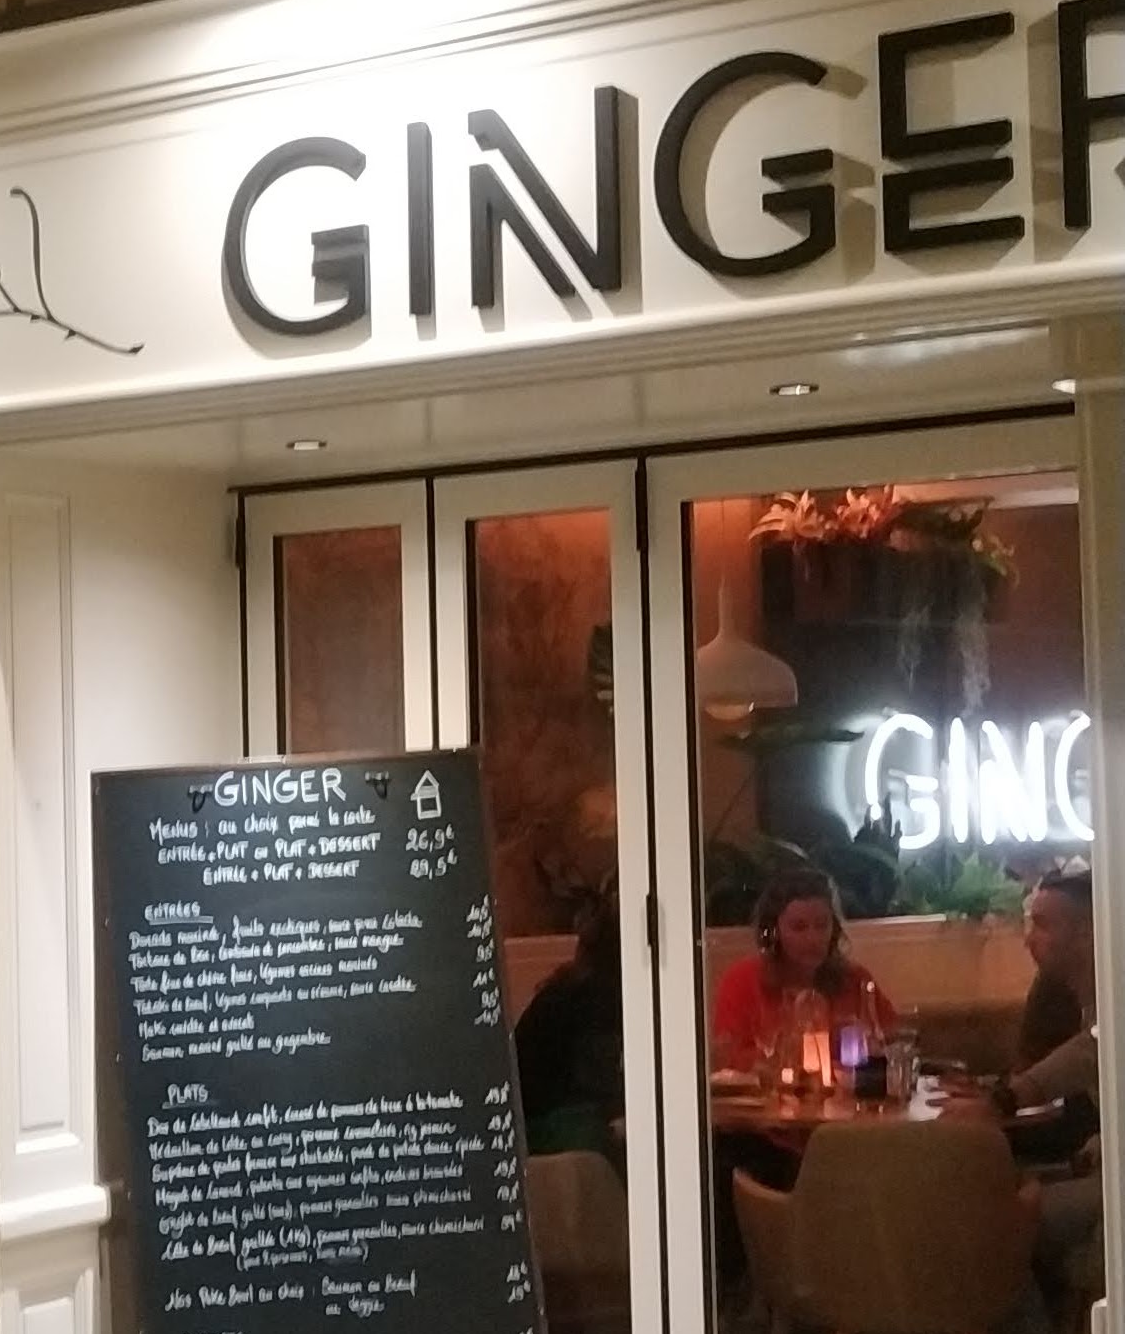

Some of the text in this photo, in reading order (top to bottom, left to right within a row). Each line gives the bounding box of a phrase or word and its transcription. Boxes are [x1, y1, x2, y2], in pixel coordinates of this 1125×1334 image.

[215, 767, 346, 807] GINGER
[275, 839, 308, 859] PLAT
[319, 832, 381, 856] DESSERT
[263, 862, 294, 882] PLAT
[308, 859, 360, 879] DESSERT
[167, 1083, 209, 1105] PLATS
